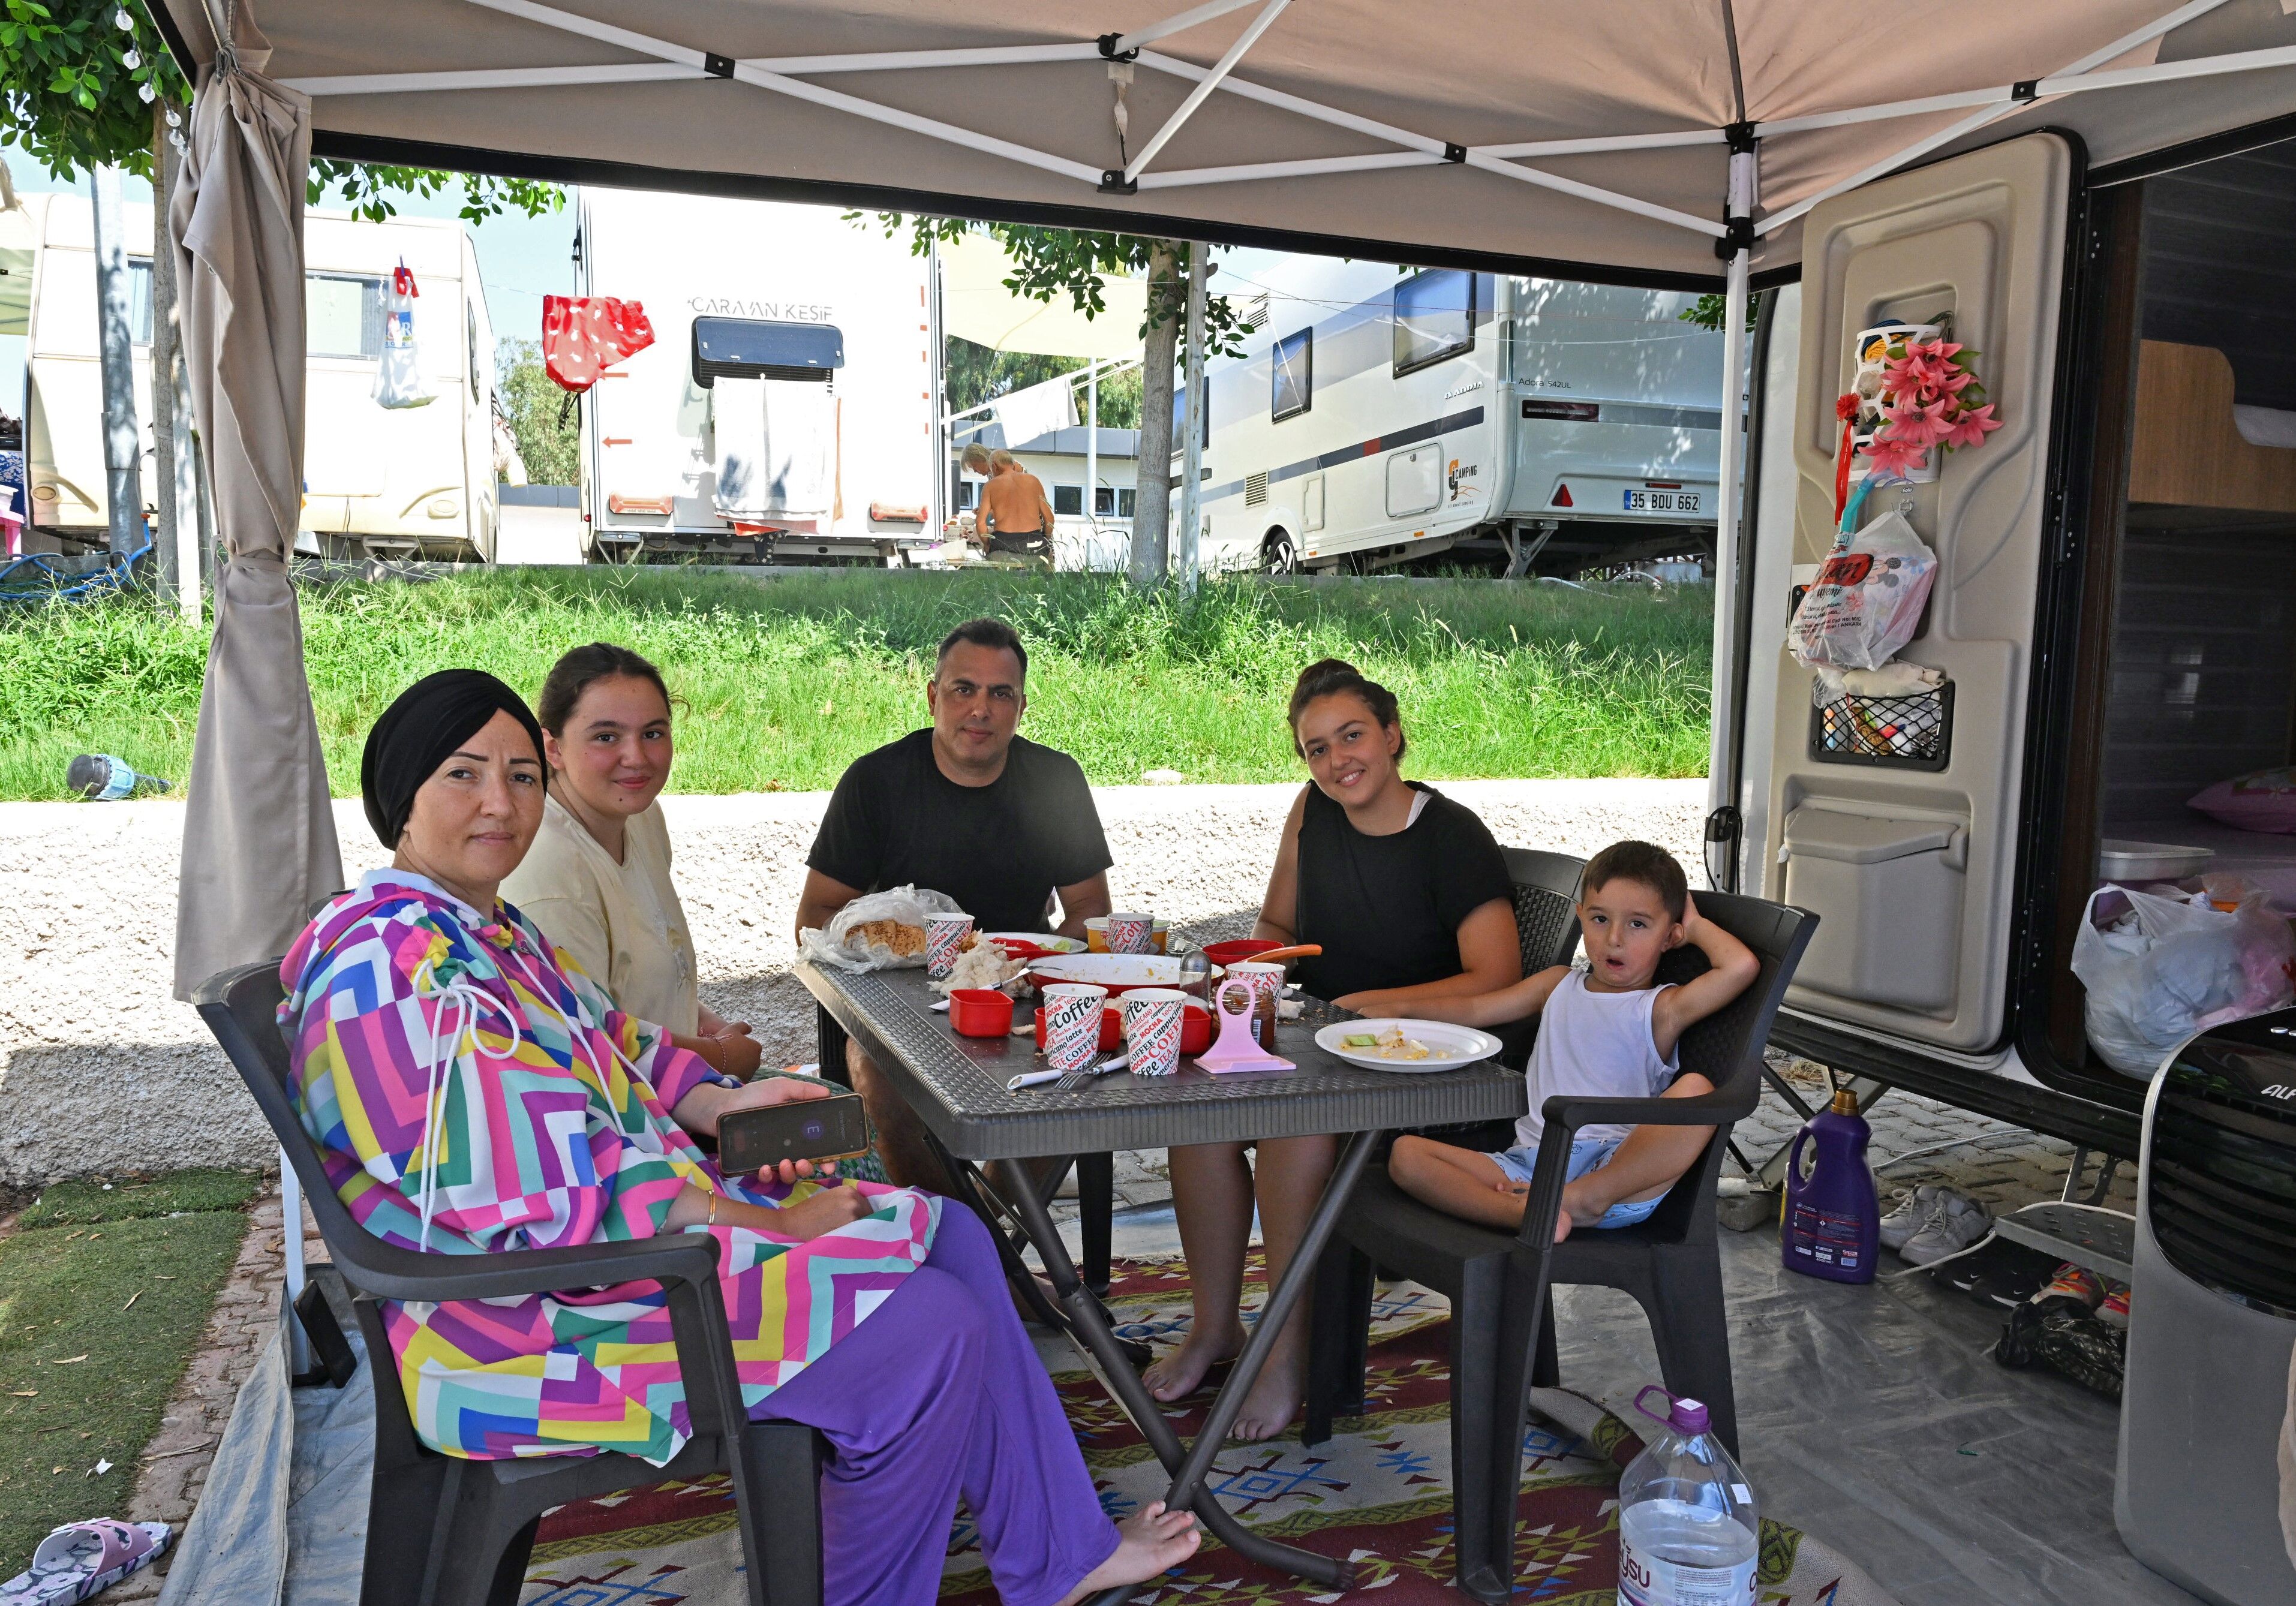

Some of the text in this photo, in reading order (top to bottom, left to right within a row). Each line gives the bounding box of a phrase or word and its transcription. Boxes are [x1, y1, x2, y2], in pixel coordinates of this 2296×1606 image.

[1518, 378, 1544, 387] Adora
[1631, 493, 1699, 510] 35 BDU 662
[931, 933, 948, 948] MOCHA
[941, 922, 966, 949] cappucino
[1073, 1003, 1100, 1030] AMERICANO
[1153, 1002, 1183, 1039] cappucino
[1162, 1006, 1173, 1017] tea
[1056, 1027, 1071, 1038] Mocha
[1066, 1028, 1083, 1042] latte
[1140, 1017, 1163, 1039] MOCHA
[1065, 1033, 1097, 1061] COFFEE
[1067, 1034, 1087, 1051] ESPRESSO
[1129, 1039, 1155, 1064] COFFEE
[1067, 1049, 1092, 1070] MOCHA
[1158, 1048, 1173, 1066] TEA
